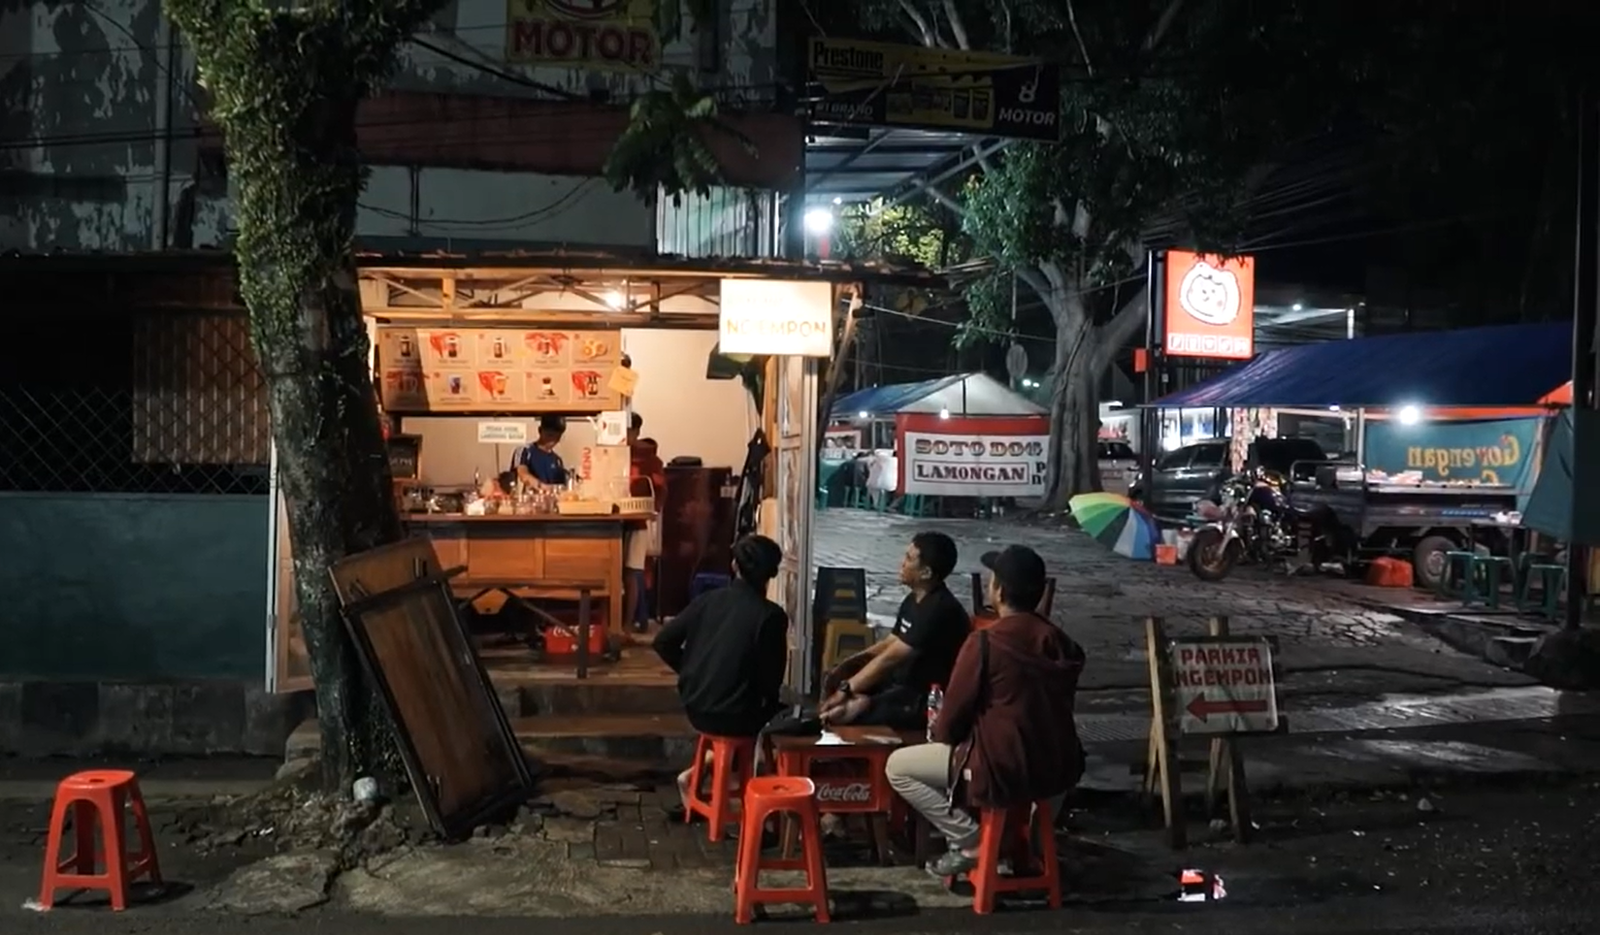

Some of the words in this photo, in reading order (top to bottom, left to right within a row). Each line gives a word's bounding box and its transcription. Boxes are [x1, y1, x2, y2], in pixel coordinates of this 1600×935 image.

[514, 18, 654, 66] MOTOR
[814, 41, 884, 69] Prestone
[998, 107, 1056, 126] MOTOR
[915, 438, 986, 457] SOTO
[582, 447, 593, 480] MENU
[916, 464, 1025, 481] LAMONGAN
[1181, 647, 1261, 665] PARKIR
[1175, 667, 1272, 687] NGEMPON
